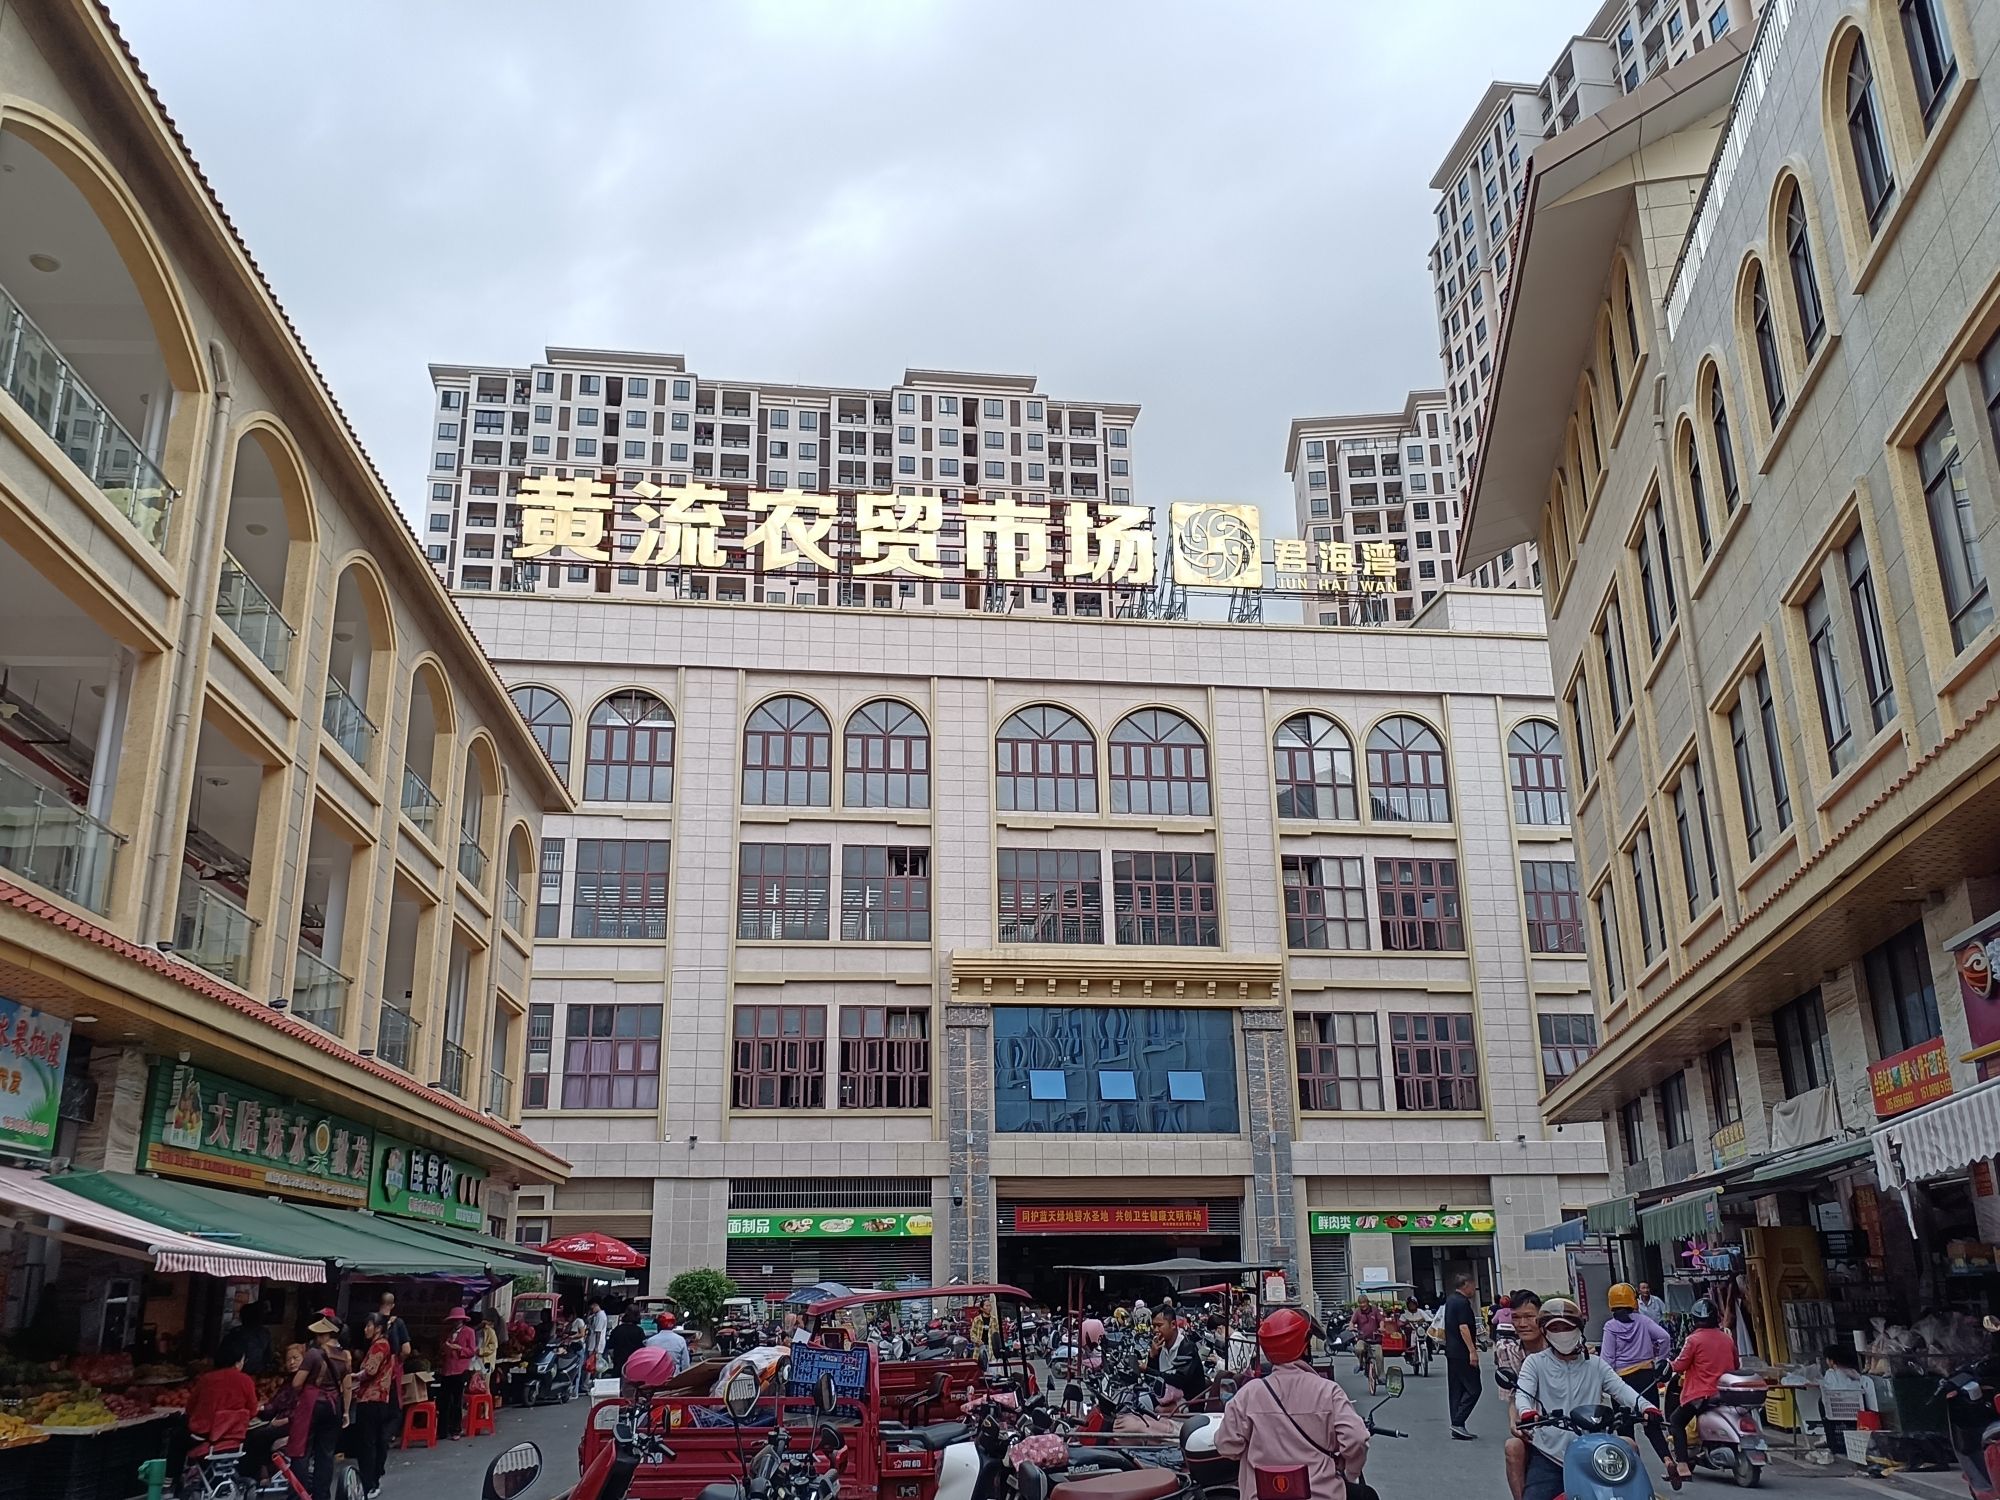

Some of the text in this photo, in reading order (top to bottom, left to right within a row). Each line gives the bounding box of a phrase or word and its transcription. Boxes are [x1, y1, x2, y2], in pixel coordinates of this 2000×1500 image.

[512, 475, 1155, 584] 黄流农贸市场
[1275, 539, 1396, 576] 君海湾
[1276, 578, 1397, 593] JUN HAI WAN
[728, 1218, 770, 1234] 面制品
[1318, 1215, 1352, 1231] 鲜肉类
